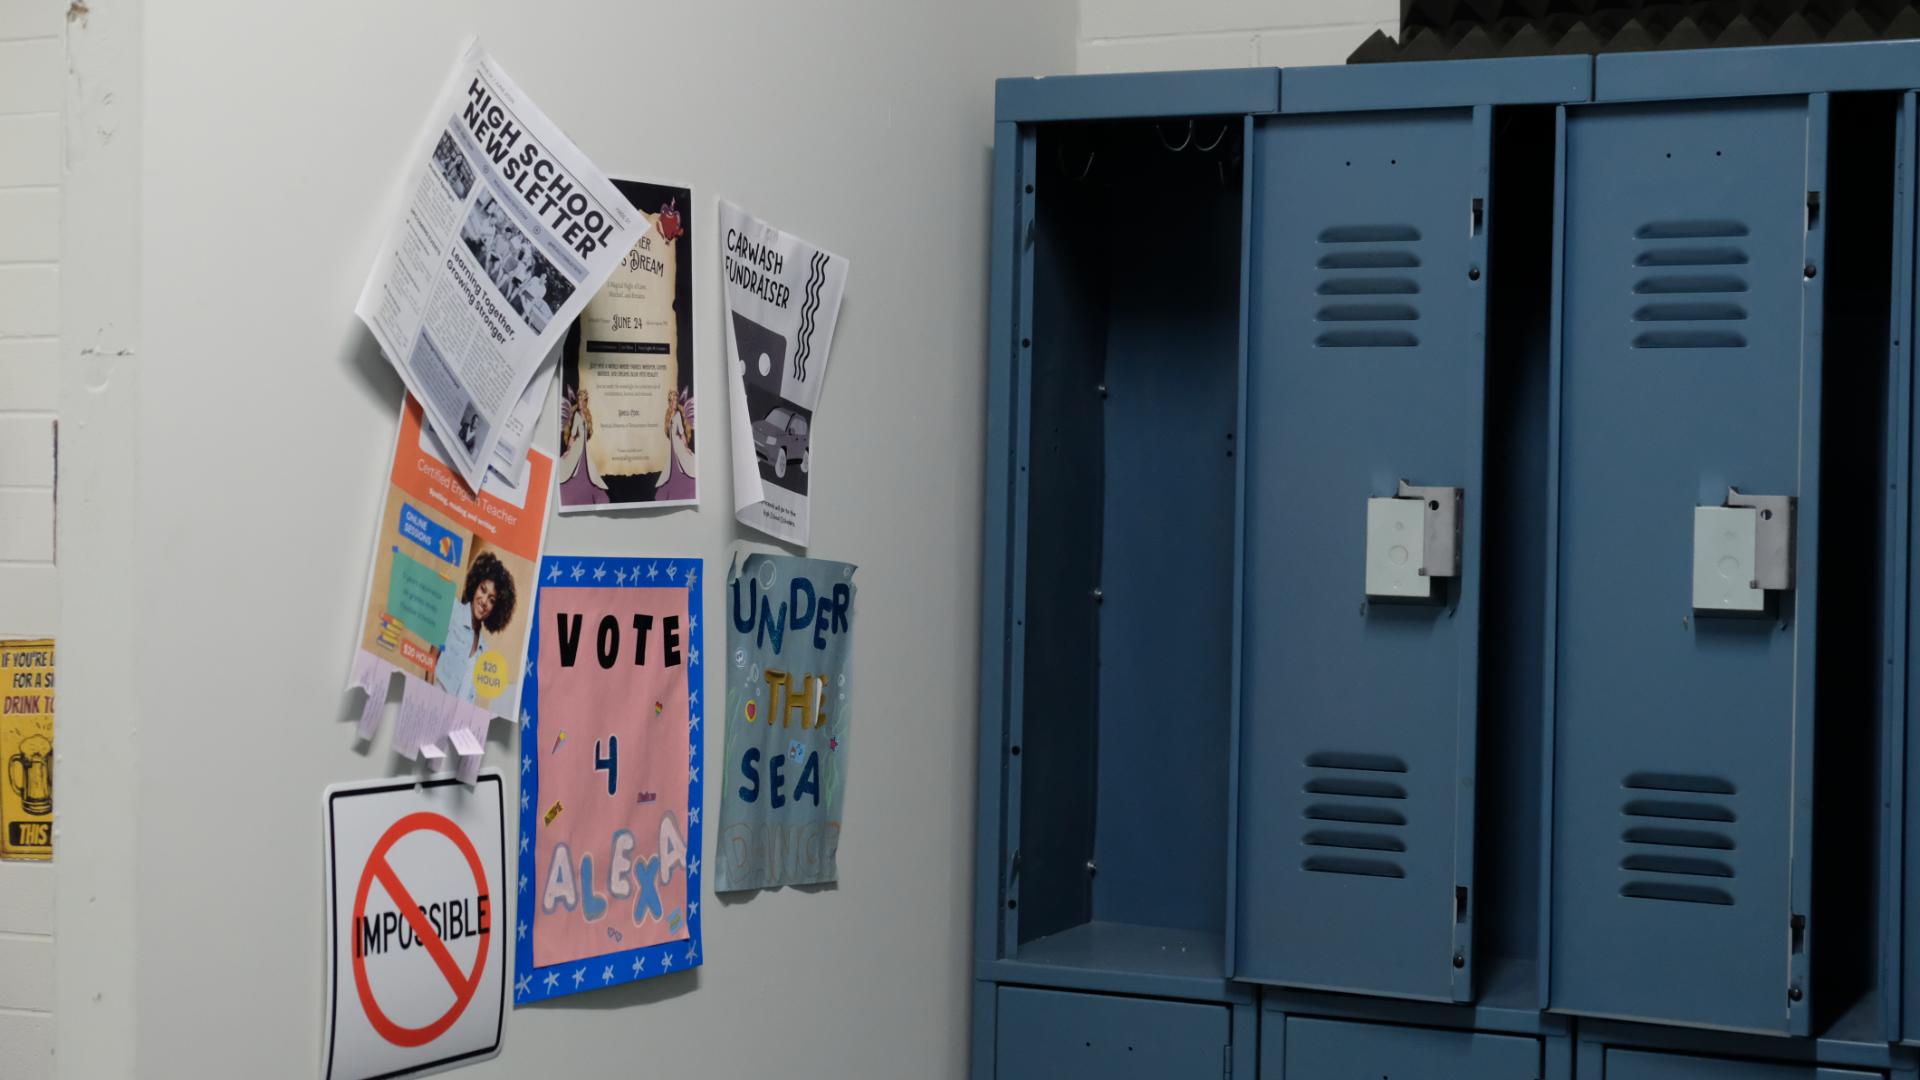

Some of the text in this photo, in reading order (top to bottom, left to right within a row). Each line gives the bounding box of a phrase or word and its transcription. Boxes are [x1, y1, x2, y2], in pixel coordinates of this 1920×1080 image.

[463, 101, 597, 260] NEWSLETTER
[468, 78, 521, 148] HIGH
[519, 143, 617, 248] SCHOOL
[629, 249, 664, 278] DREAM
[727, 228, 783, 275] CARWASH
[446, 259, 475, 306] Growing
[473, 300, 507, 345] Stronger
[450, 247, 482, 296] Learning
[480, 287, 516, 341] Together,
[725, 256, 790, 309] FUNDRAISER
[612, 313, 643, 332] JUNE 24
[417, 459, 450, 488] Certified
[482, 498, 518, 525] Teacher
[404, 522, 431, 546] SESSIONS
[406, 511, 428, 531] ONLINE
[557, 612, 681, 670] VOTE
[733, 577, 850, 655] UNDER
[1, 652, 11, 668] IF
[13, 651, 48, 668] YOU'RE
[13, 672, 33, 688] FOR
[35, 672, 42, 688] A
[477, 674, 501, 689] HOUR
[483, 660, 497, 673] $20
[3, 695, 40, 714] DRINK
[594, 734, 618, 795] 4
[738, 747, 820, 809] SEA
[19, 823, 49, 846] THIS
[543, 811, 687, 927] ALEXA
